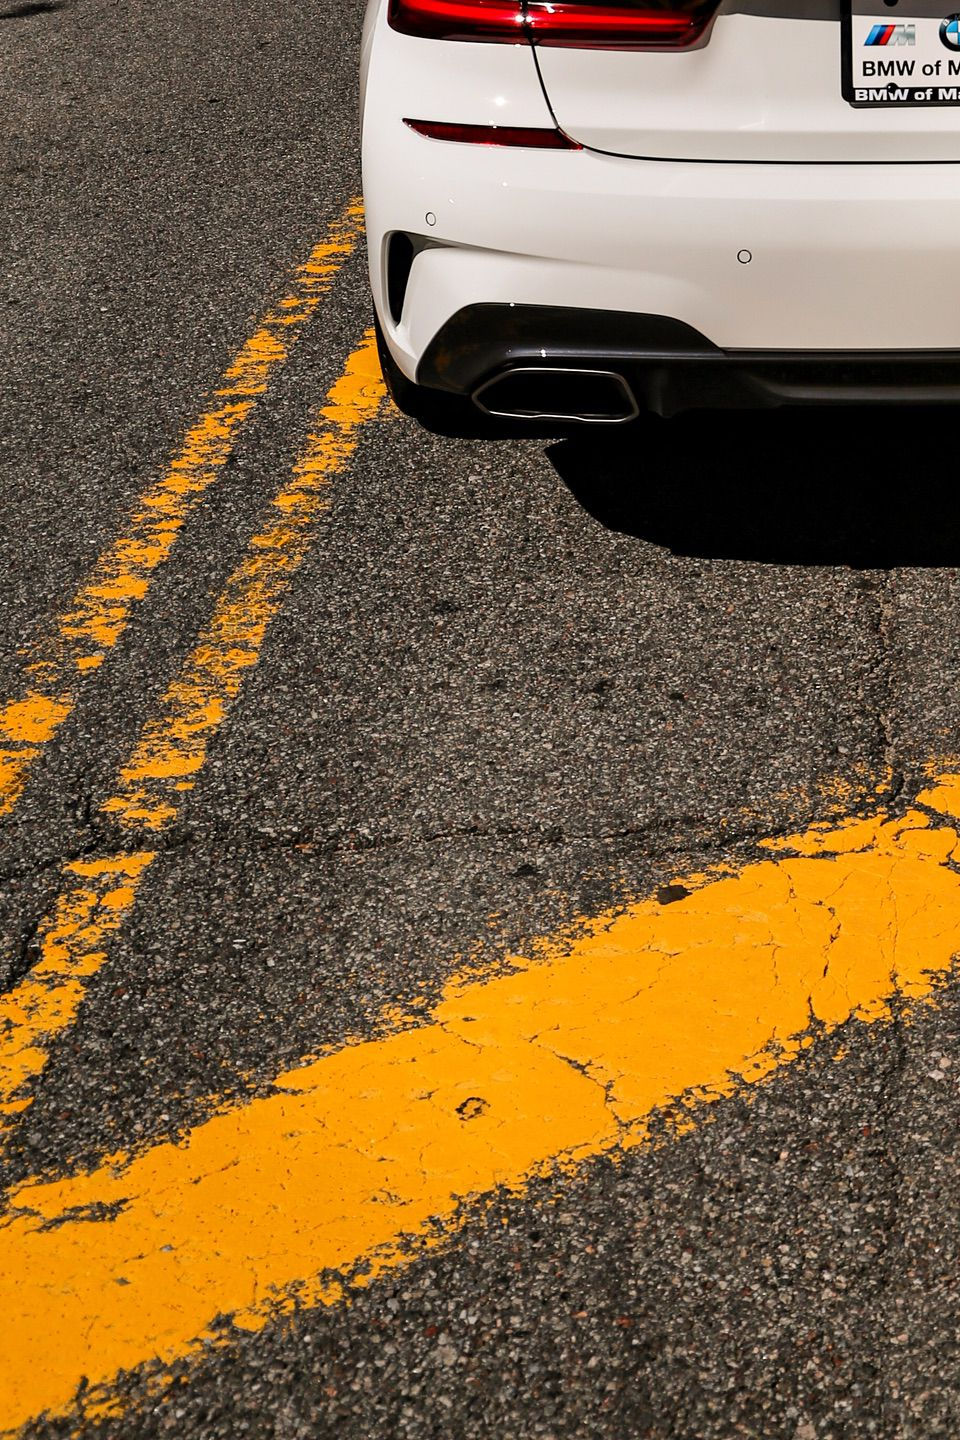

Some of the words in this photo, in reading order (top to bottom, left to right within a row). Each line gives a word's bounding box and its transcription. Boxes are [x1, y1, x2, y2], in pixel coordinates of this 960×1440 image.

[862, 60, 915, 77] BMW
[921, 60, 942, 76] of
[854, 88, 910, 101] BMW
[914, 88, 934, 101] of
